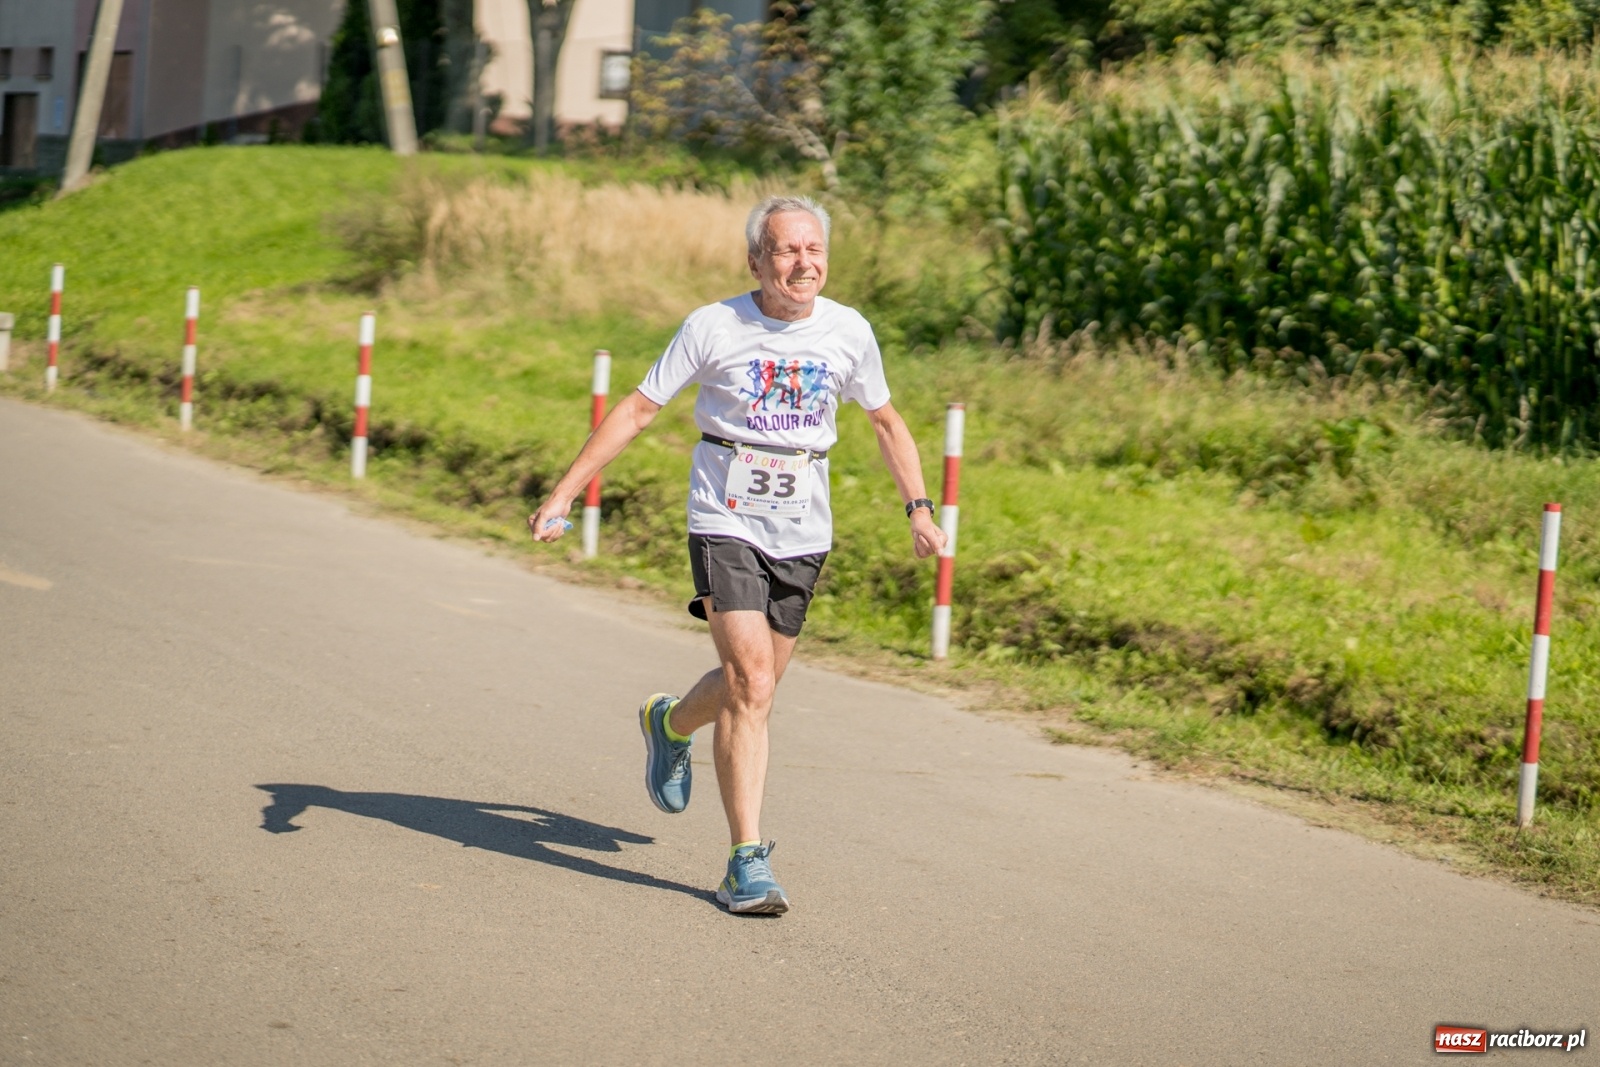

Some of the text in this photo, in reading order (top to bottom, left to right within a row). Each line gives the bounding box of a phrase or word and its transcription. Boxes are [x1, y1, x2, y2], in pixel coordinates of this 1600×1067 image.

[746, 413, 800, 431] COLOUR
[738, 452, 786, 471] COLOUR
[746, 469, 797, 498] 33
